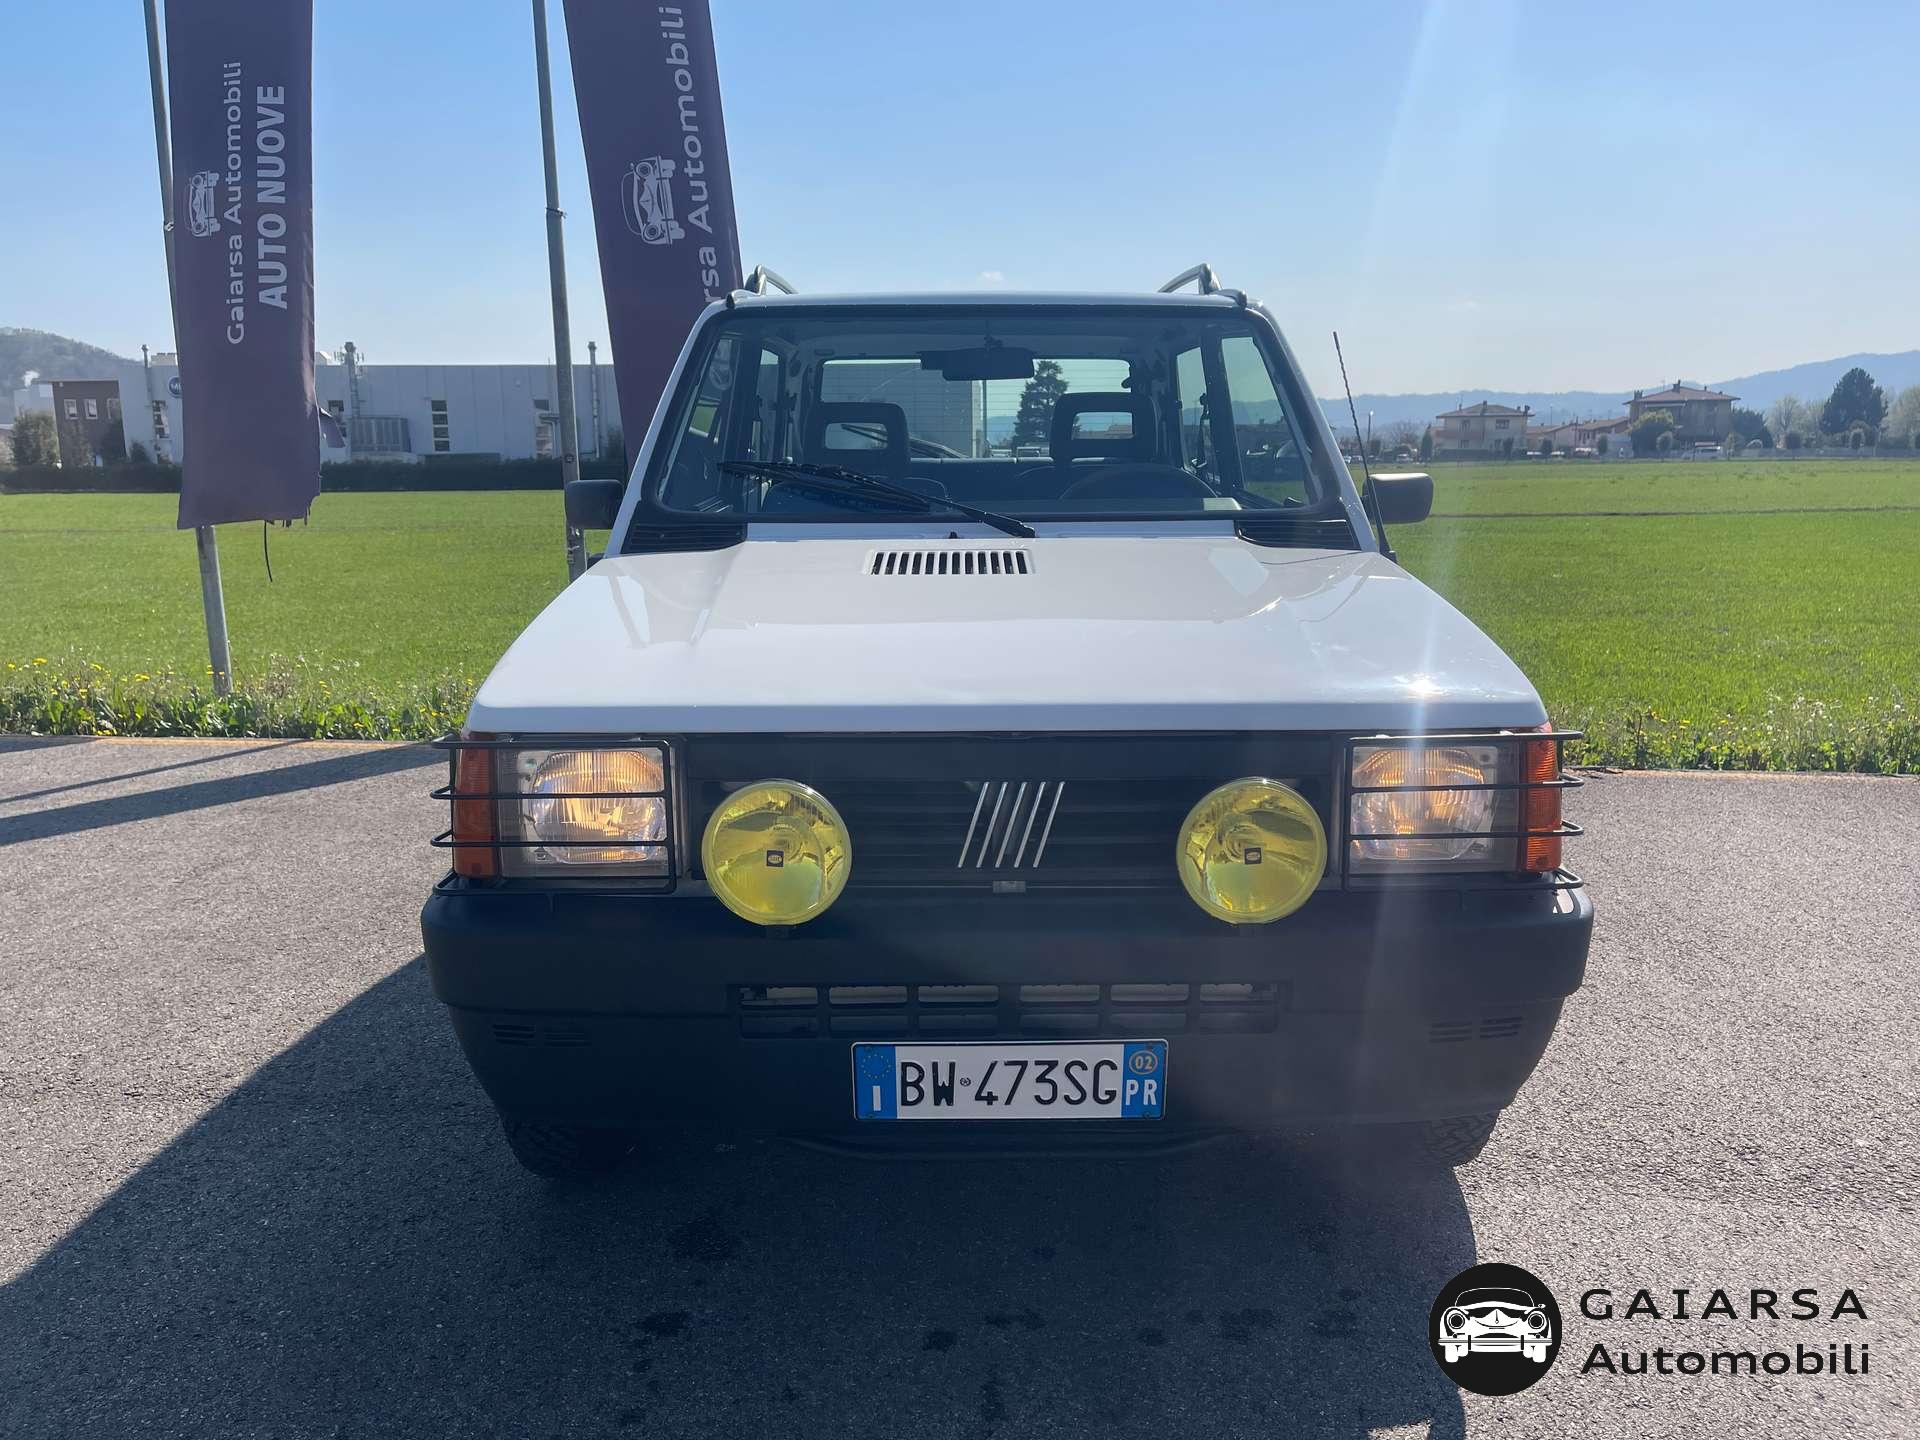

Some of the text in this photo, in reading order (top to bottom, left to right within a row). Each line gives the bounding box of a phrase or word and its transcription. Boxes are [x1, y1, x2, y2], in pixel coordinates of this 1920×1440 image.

[658, 6, 721, 303] rsa Automobili
[223, 62, 245, 344] Gaiarsa Automobili
[256, 85, 287, 310] AUTO NUOVE
[900, 1060, 956, 1107] BW
[1135, 1055, 1153, 1070] 02
[872, 1085, 882, 1112] I
[1125, 1079, 1157, 1106] PR
